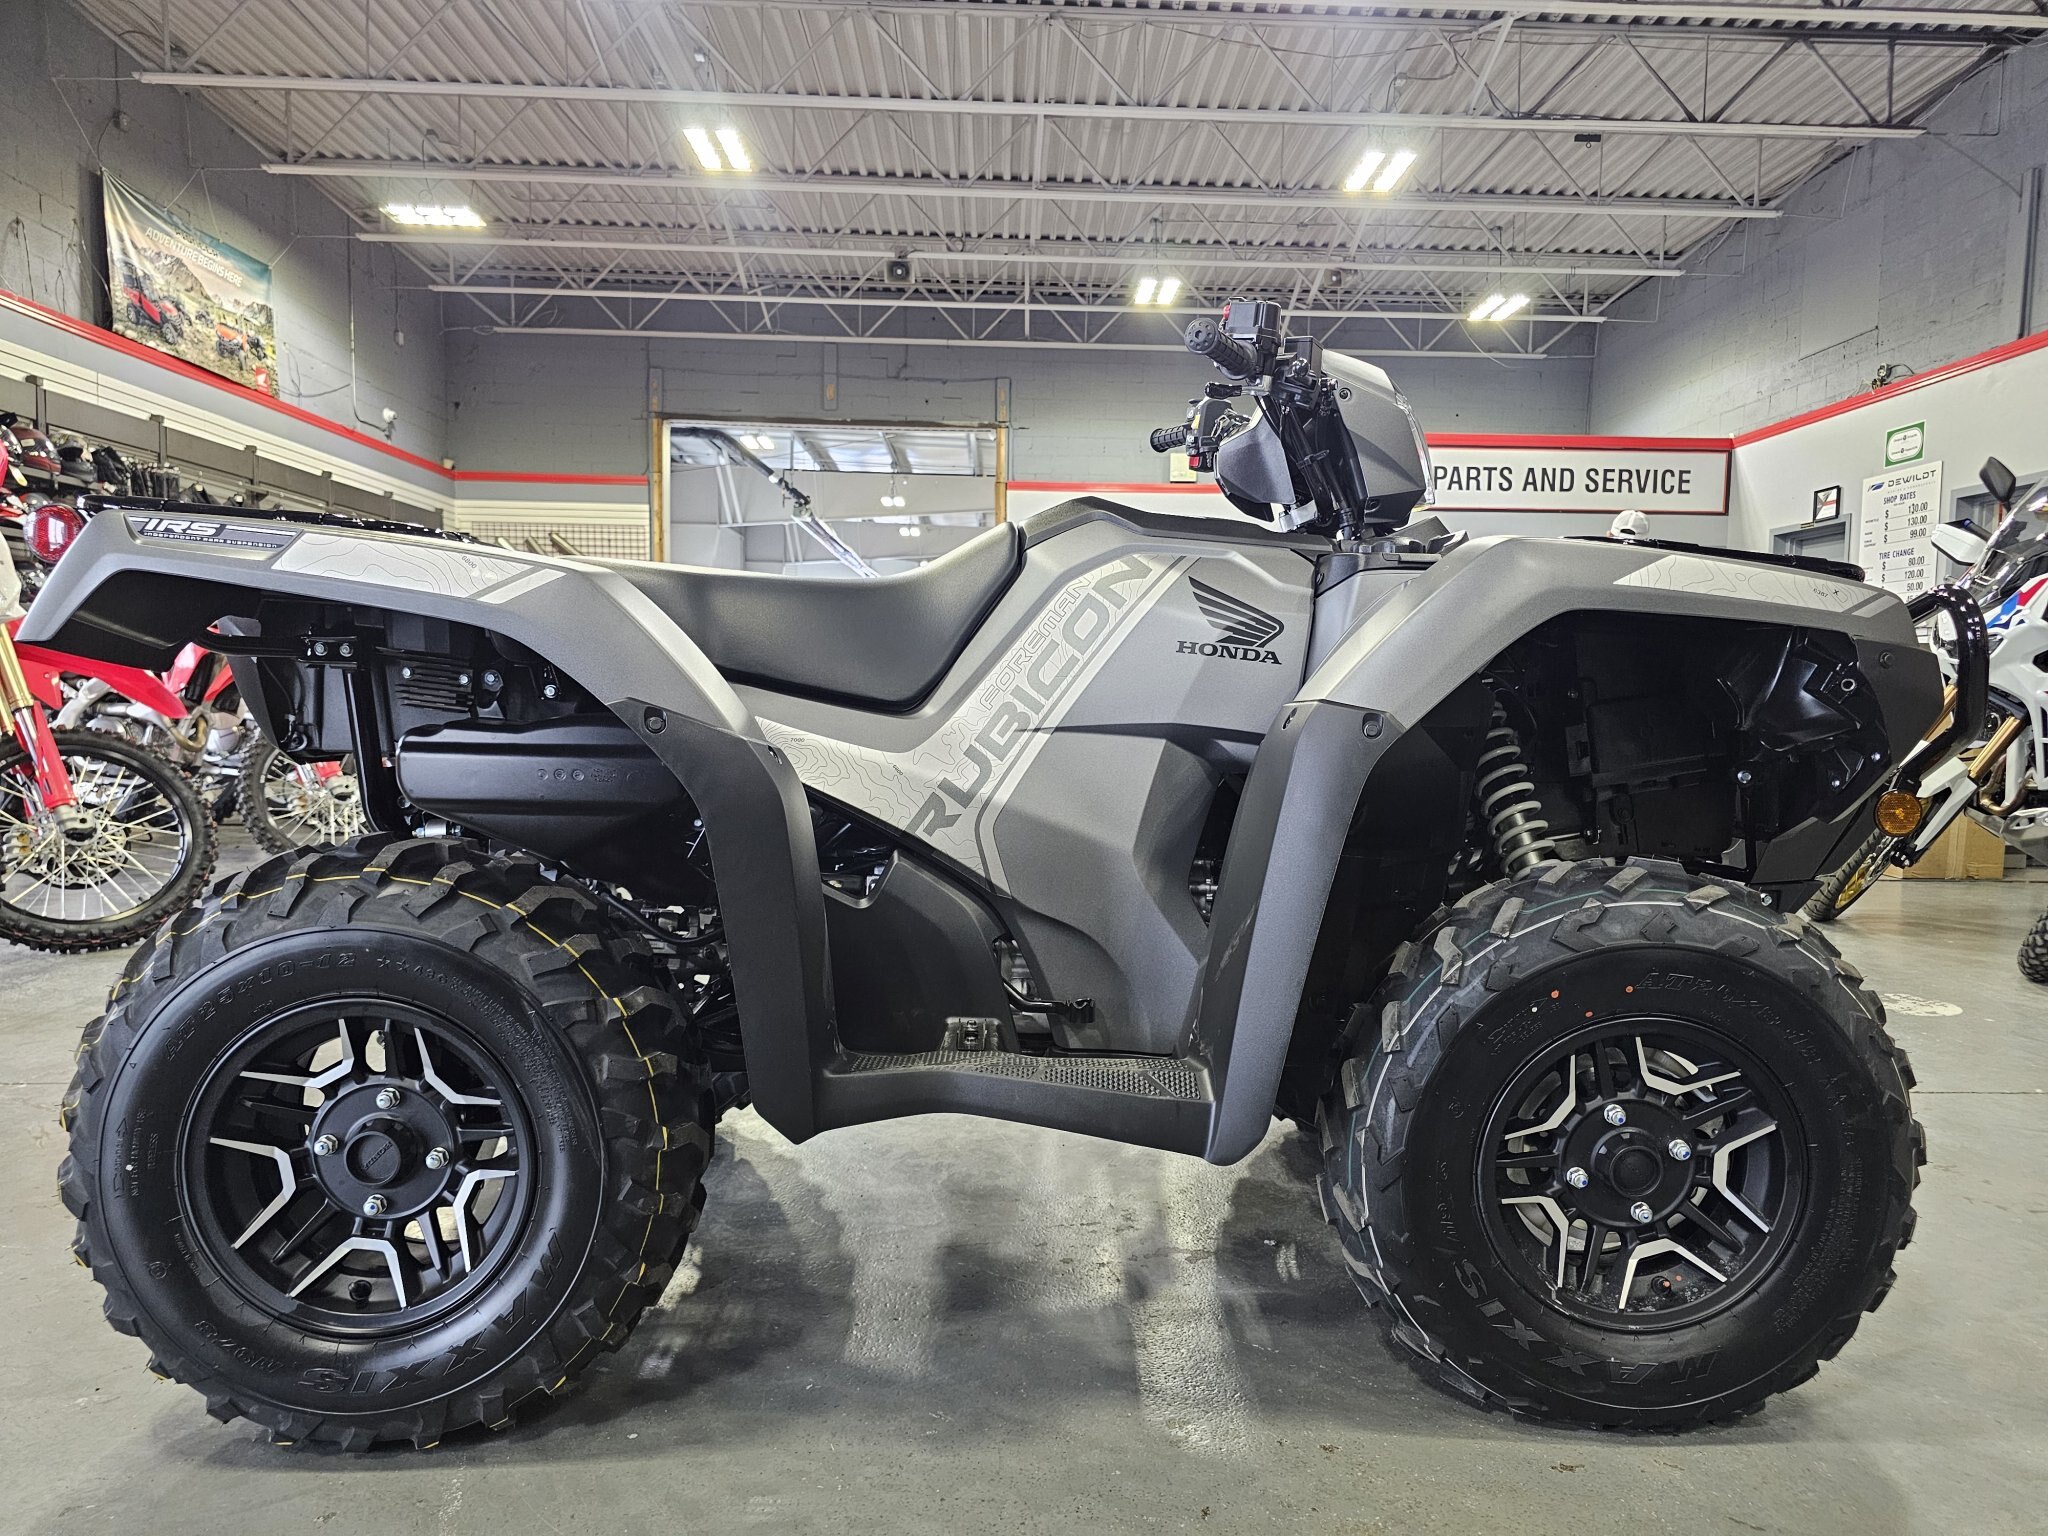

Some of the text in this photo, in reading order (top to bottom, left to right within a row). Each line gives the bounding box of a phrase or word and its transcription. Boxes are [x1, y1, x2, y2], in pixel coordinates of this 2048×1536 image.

[145, 227, 198, 261] ADVENTURE
[197, 254, 226, 277] BEGINS
[223, 267, 243, 287] HERE
[1433, 465, 1692, 495] PARTS AND SERVICE
[1887, 469, 1937, 488] DEWILDT
[1883, 491, 1916, 505] SHOP RATES
[144, 518, 221, 536] IRS
[1907, 515, 1928, 527] 130.00
[1910, 528, 1927, 539] 99.00
[1879, 548, 1914, 560] TIRE CHANGE
[1908, 556, 1925, 566] 80.00
[1904, 568, 1924, 579] 120.00
[1906, 582, 1924, 591] 50.00
[980, 578, 1093, 711] FOREMAN
[1176, 640, 1282, 665] HONDA
[904, 554, 1153, 838] RUBICON
[297, 1231, 565, 1395] MAXXIS
[1452, 1257, 1718, 1385] MAXXIS
